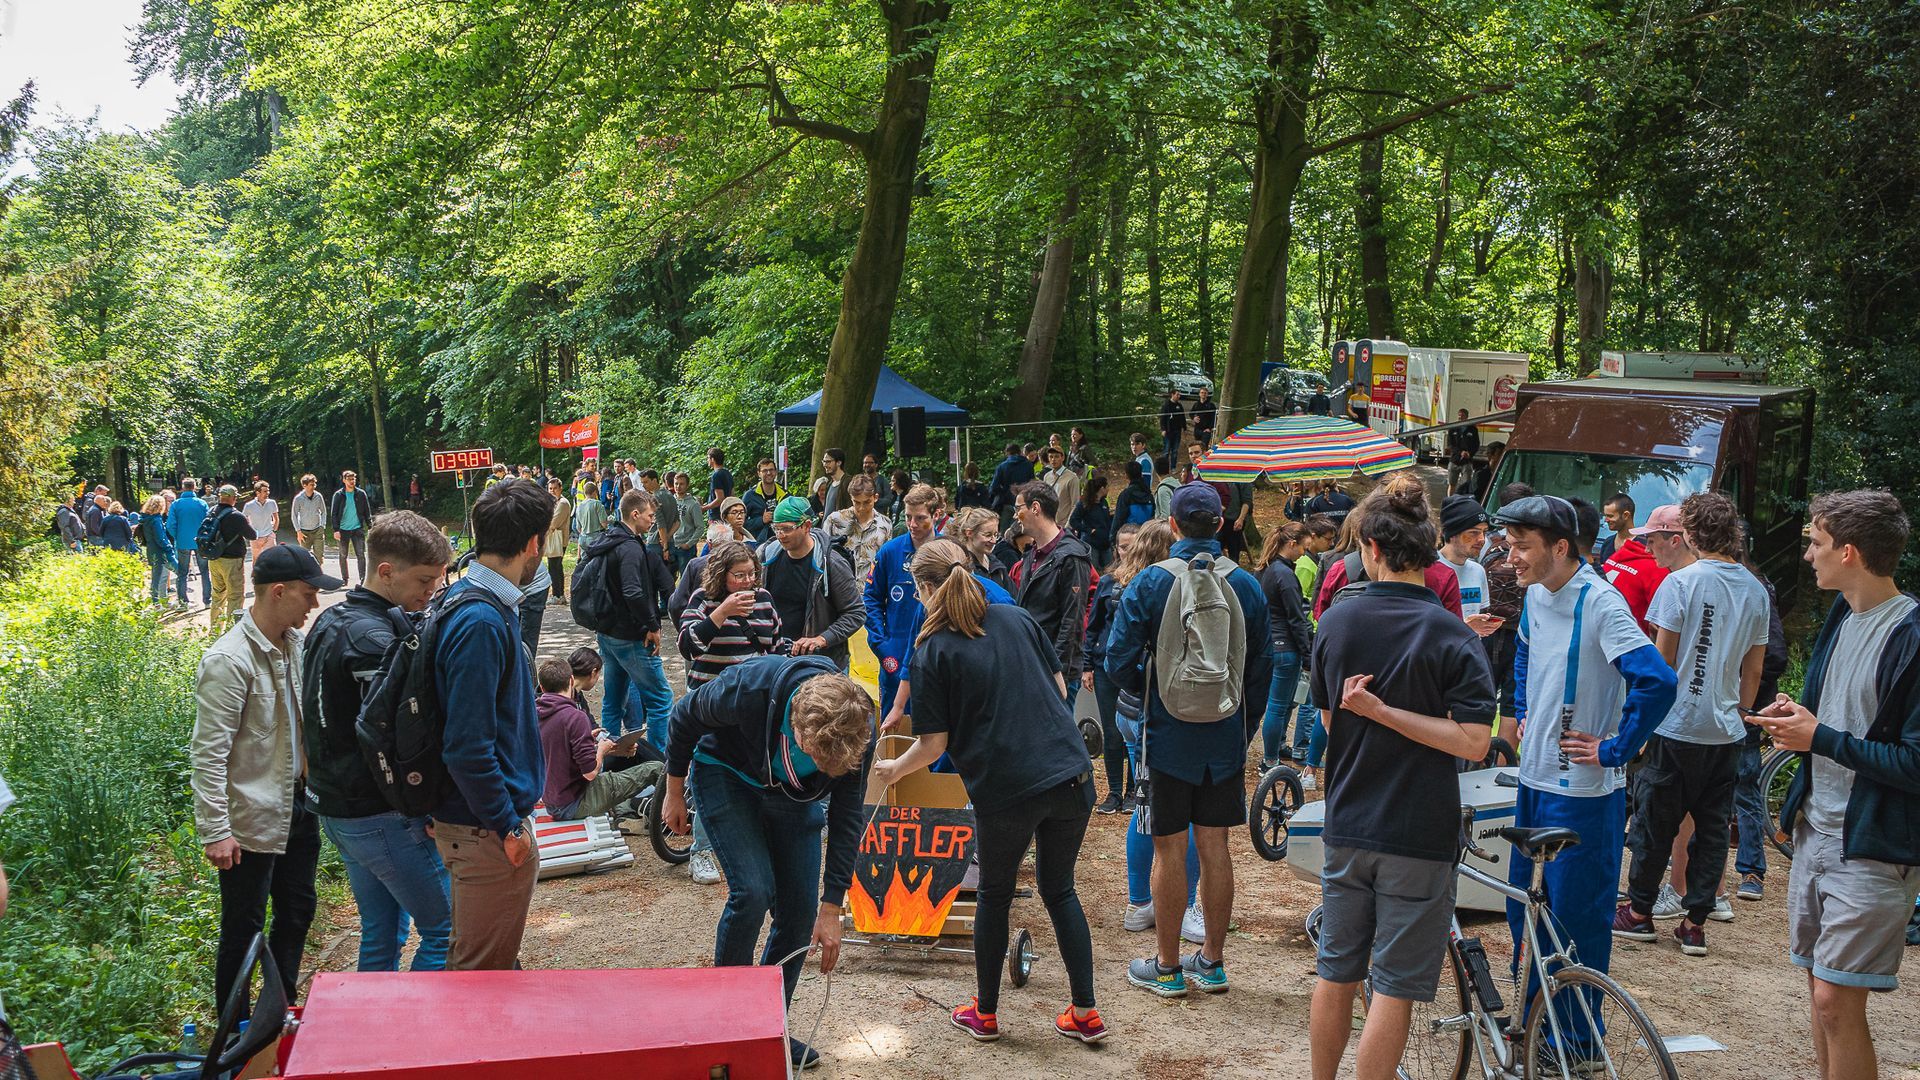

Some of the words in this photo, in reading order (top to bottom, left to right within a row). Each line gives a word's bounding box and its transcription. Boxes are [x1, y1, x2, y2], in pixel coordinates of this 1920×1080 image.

[1380, 374, 1405, 382] BREUER
[434, 451, 491, 469] 039.84
[1688, 602, 1715, 696] #berndpower
[890, 807, 921, 820] DER
[859, 821, 973, 860] AFFLER
[1156, 974, 1175, 983] HOKA
